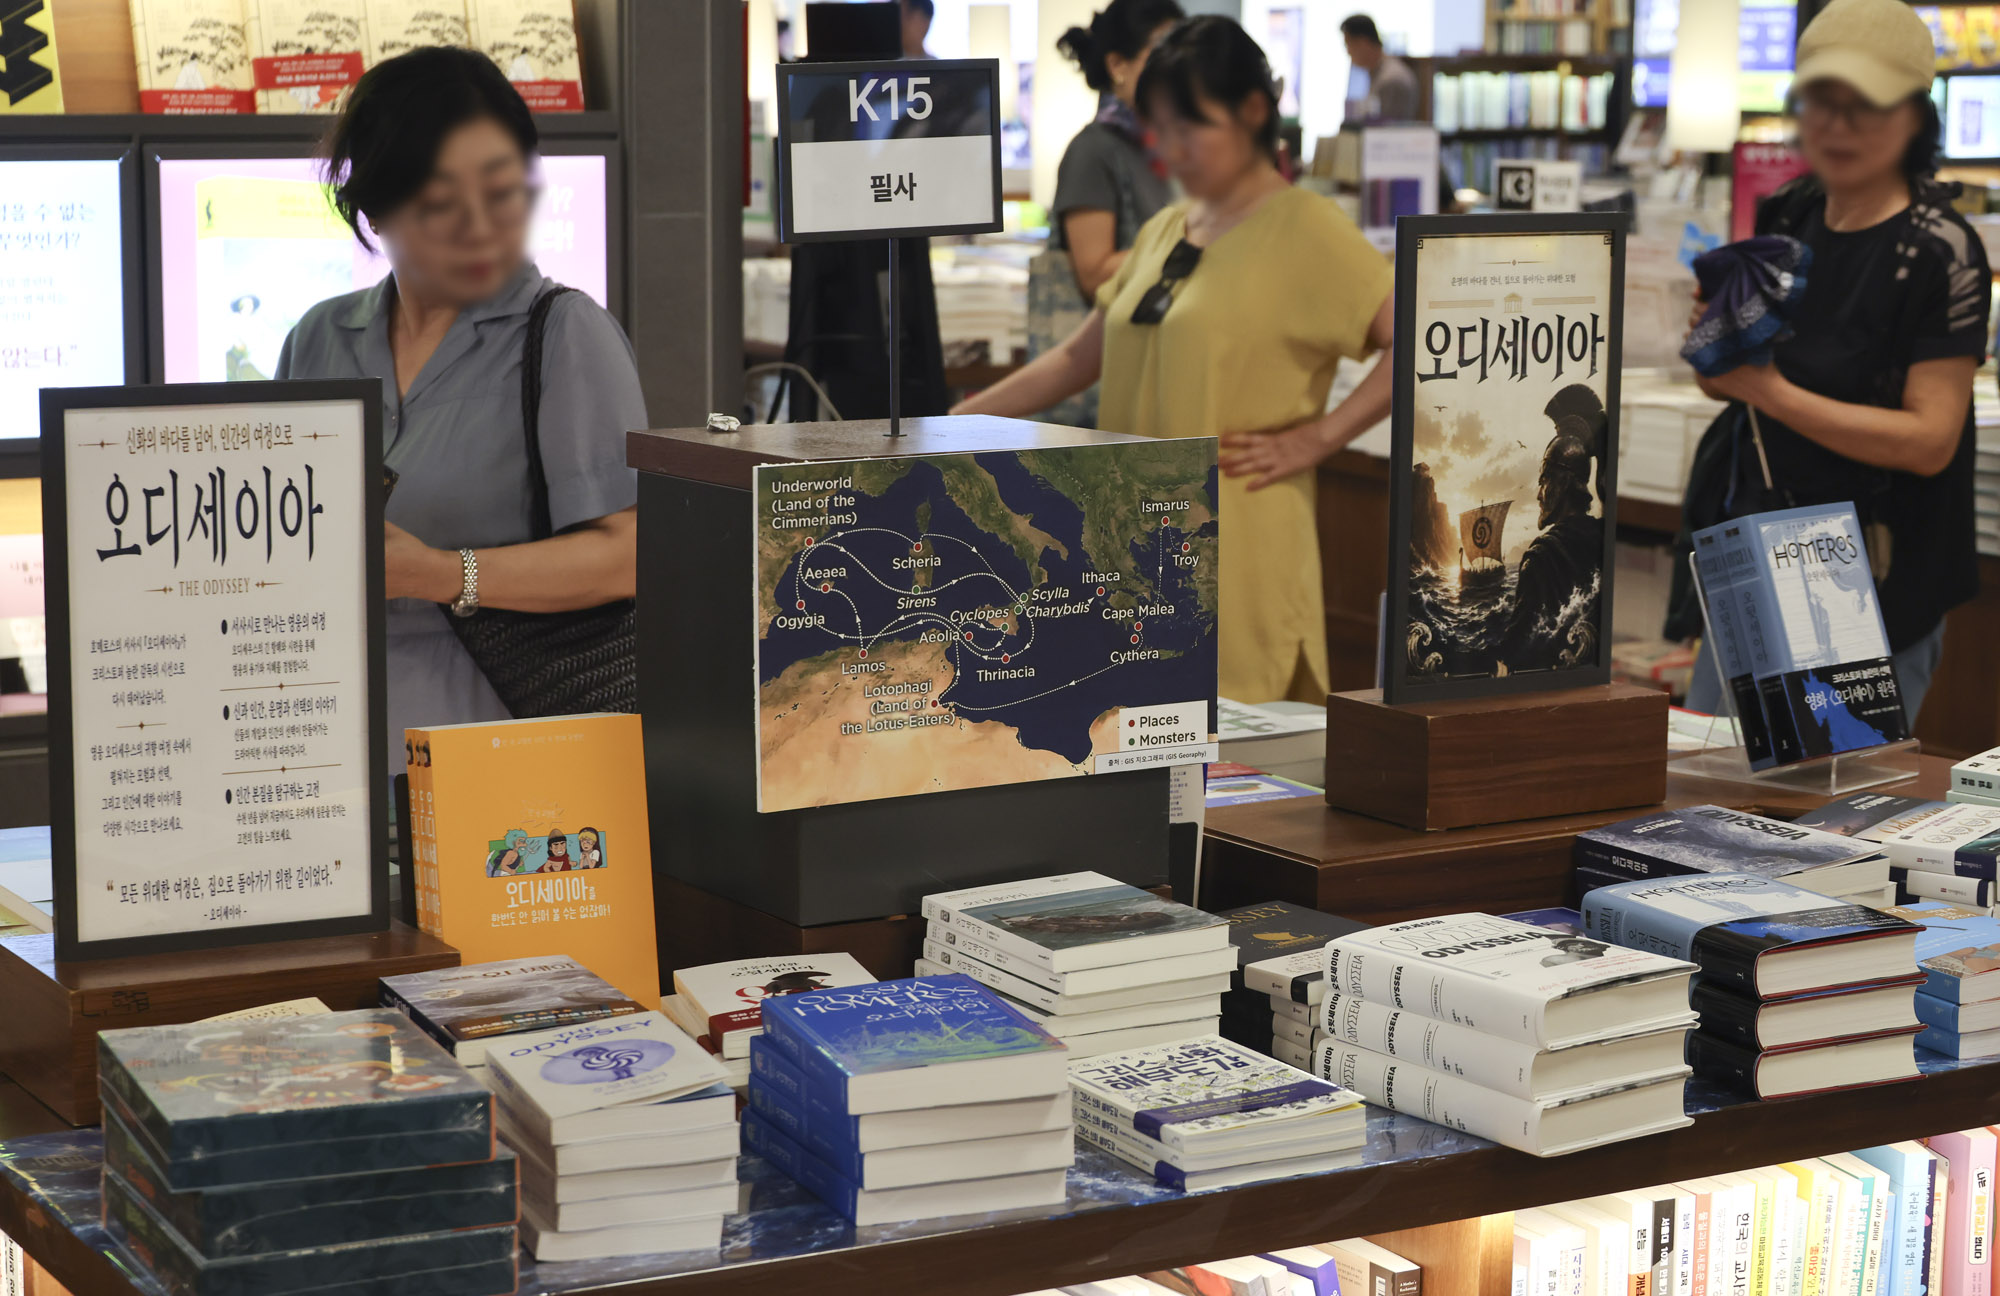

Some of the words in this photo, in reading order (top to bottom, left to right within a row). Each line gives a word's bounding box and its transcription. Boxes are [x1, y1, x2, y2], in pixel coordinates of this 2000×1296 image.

[849, 77, 933, 122] K15
[870, 172, 917, 202] 필사
[1470, 275, 1487, 286] 바다를
[1504, 274, 1520, 285] 집으로
[1522, 274, 1545, 285] 돌아가는
[1547, 273, 1563, 284] 위대한
[1565, 273, 1576, 284] 모험
[1416, 312, 1605, 385] 오디세이아
[126, 426, 157, 454] 신화의
[160, 425, 190, 453] 바다를
[194, 424, 217, 453] 넘어,
[220, 423, 249, 451] 인간의
[254, 422, 294, 450] 여정으로
[772, 477, 852, 494] Underworld
[771, 497, 812, 514] (Land
[816, 496, 830, 509] of
[834, 495, 855, 508] the
[1142, 500, 1190, 514] Ismarus
[96, 464, 323, 569] 오디세이아
[772, 511, 858, 530] Cimmerians)
[1173, 555, 1200, 568] Troy
[1773, 534, 1858, 569] HOMEROS
[892, 554, 942, 571] Scheria
[805, 567, 847, 580] Aeaea
[1082, 571, 1120, 584] Ithaca
[179, 580, 200, 597] THE
[203, 577, 251, 596] ODYSSEY
[1031, 587, 1070, 602] Scylla
[896, 596, 937, 610] Sirens
[1026, 602, 1090, 619] Charybdis
[1102, 608, 1134, 621] Cape
[1138, 604, 1175, 617] Malea
[232, 616, 262, 636] 서사시로
[263, 615, 286, 634] 만나는
[288, 613, 309, 632] 영웅의
[311, 612, 325, 631] 여정
[776, 613, 825, 630] Ogygia
[950, 605, 1009, 623] Cyclopes
[919, 630, 960, 645] Aeolia
[1110, 649, 1159, 664] Cythera
[841, 661, 886, 676] Lamos
[976, 666, 1035, 682] Thrinacia
[112, 691, 125, 707] 다시
[864, 680, 932, 698] Lotophagi
[1805, 691, 1827, 711] 영화
[1877, 679, 1897, 698] 원작
[234, 701, 248, 721] 신과
[250, 700, 267, 720] 인간,
[268, 698, 290, 719] 운명과
[292, 697, 313, 717] 선택의
[315, 695, 336, 715] 이야기
[870, 698, 909, 716] (Land
[913, 698, 927, 710] of
[841, 722, 863, 735] the
[866, 713, 956, 733] Lotus-Eaters)
[1139, 714, 1179, 729] Places
[1139, 730, 1196, 747] Monsters
[91, 745, 104, 761] 영웅
[105, 742, 143, 758] 오디세우스의
[159, 740, 171, 755] 여정
[172, 738, 192, 754] 속에서
[1108, 758, 1120, 767] 출처
[1125, 757, 1134, 765] GIS
[1136, 754, 1164, 764] 지오그래피
[1166, 752, 1177, 762] (GIS
[1178, 750, 1207, 761] Georaphy)
[102, 796, 120, 810] 그리고
[123, 793, 141, 810] 인간에
[143, 792, 155, 808] 대한
[157, 790, 182, 806] 이야기를
[236, 786, 250, 804] 인간
[252, 784, 273, 803] 본질을
[275, 782, 304, 802] 탐구하는
[306, 780, 320, 798] 고전
[103, 821, 122, 837] 다양한
[1696, 808, 1811, 841] ODYSSEIA
[1612, 855, 1649, 874] 오디세이아
[120, 883, 138, 904] 모든
[142, 880, 170, 903] 위대한
[174, 877, 205, 900] 여정은,
[207, 874, 235, 897] 집으로
[237, 870, 272, 895] 돌아가기
[275, 868, 292, 891] 위한
[1631, 878, 1770, 900] HOMEROS
[519, 912, 528, 924] 안
[531, 910, 550, 923] 읽어
[553, 908, 560, 921] 볼
[563, 907, 576, 920] 수는
[1421, 930, 1549, 960] ODYSSEIA
[1330, 948, 1341, 992] 오뒷세이아
[1392, 965, 1403, 1009] ODYSSEIA
[793, 985, 978, 1017] HOMEROS
[865, 998, 992, 1023] 오디세이아
[1328, 993, 1341, 1036] 오뒷세이아
[509, 1018, 654, 1059] ODYSSEY
[554, 1024, 599, 1041] THE
[1388, 1011, 1400, 1055] ODYSSEIA
[1425, 1030, 1433, 1060] HOMEROS
[1103, 1054, 1251, 1090] 해부도감
[1389, 1065, 1397, 1110] ODYSSEIA
[1977, 1171, 1987, 1188] 나는
[1875, 1197, 1884, 1218] 교사가
[1661, 1217, 1670, 1244] 서울대
[1698, 1211, 1708, 1250] 물질과의
[1735, 1213, 1750, 1255] 한국의
[1909, 1225, 1918, 1234] 새
[1775, 1239, 1788, 1264] 다시,
[1906, 1235, 1917, 1249] 길을
[1660, 1246, 1669, 1266] 10개
[1905, 1251, 1915, 1267] 열다
[1696, 1253, 1706, 1282] 새로운
[1659, 1269, 1668, 1295] 만들기
[1866, 1277, 1874, 1294] 산다
